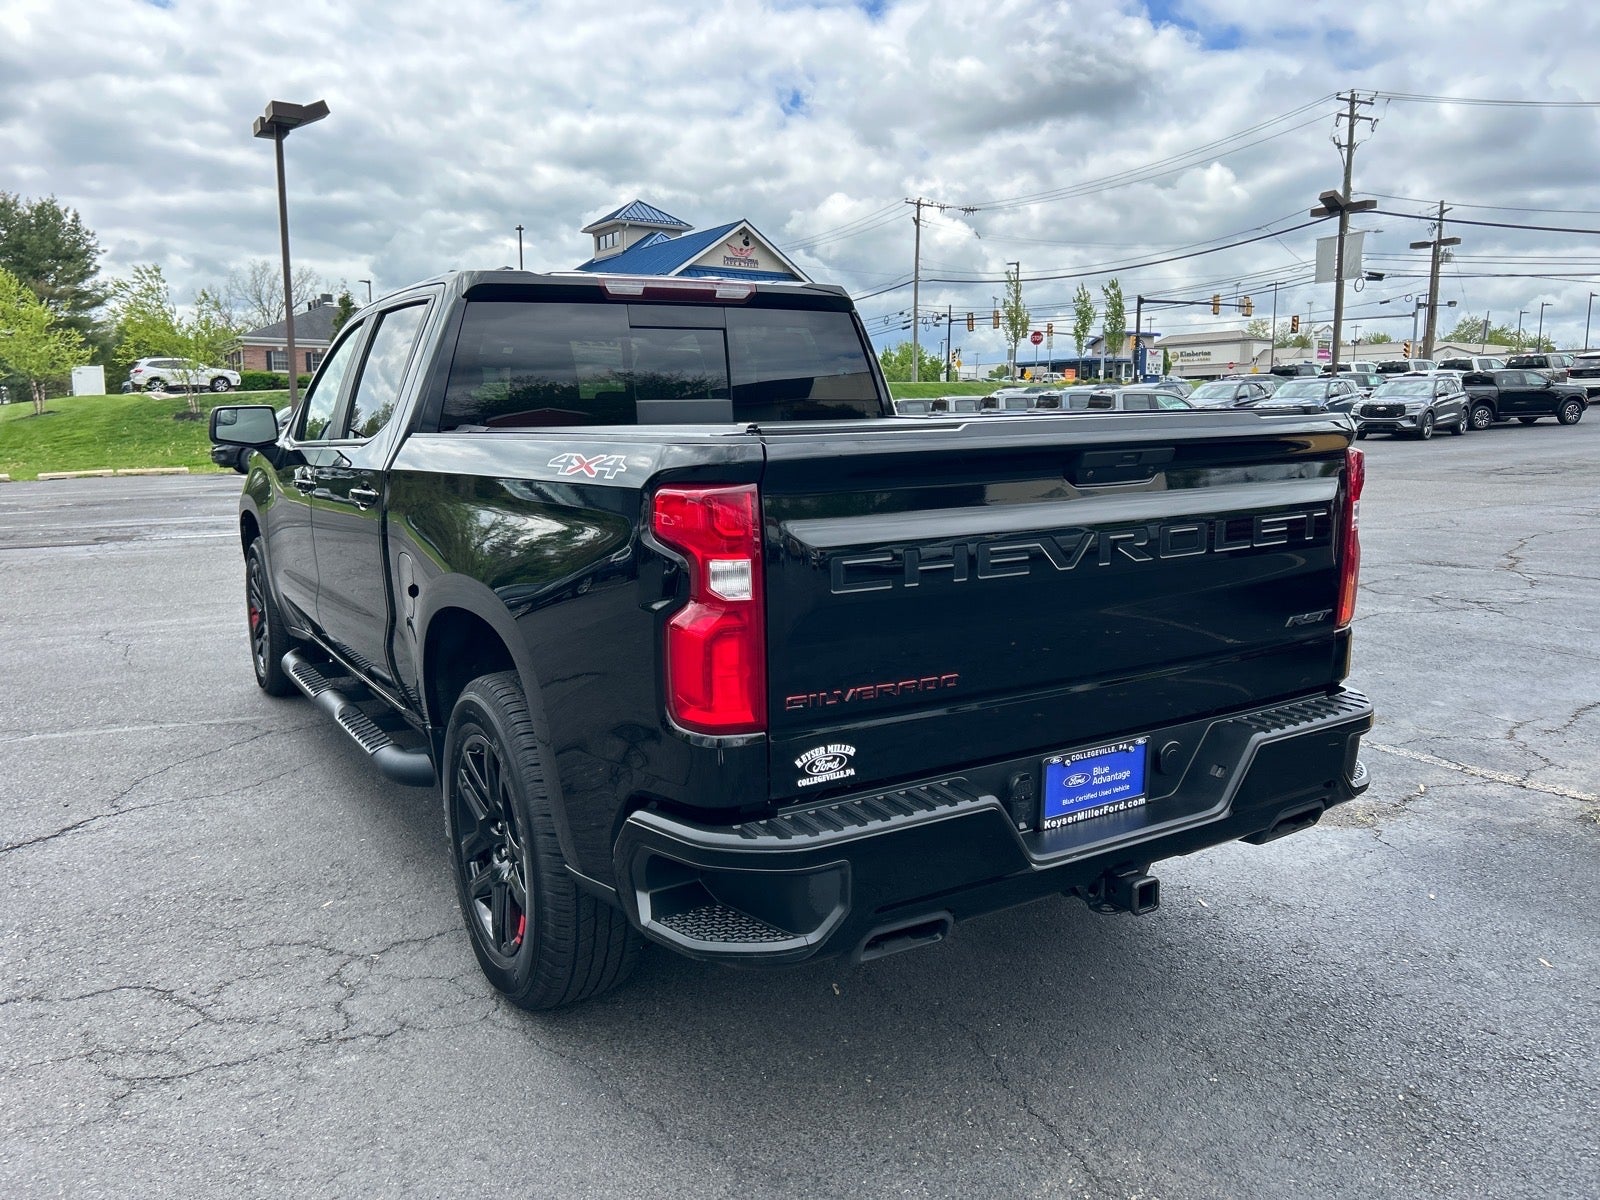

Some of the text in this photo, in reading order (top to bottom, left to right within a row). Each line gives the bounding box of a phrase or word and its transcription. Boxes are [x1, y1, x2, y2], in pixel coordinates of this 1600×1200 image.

[1180, 350, 1211, 358] Kimberton
[830, 508, 1328, 594] CHEVROLET
[1285, 609, 1333, 628] RST
[786, 673, 960, 711] SILVERADO
[794, 744, 856, 769] KEYSER MILLER
[1071, 746, 1117, 762] COLLEGEVILLE,
[1118, 743, 1127, 751] PA
[812, 756, 840, 773] Ford
[1092, 766, 1110, 776] Blue
[1068, 775, 1086, 787] Ford
[1092, 770, 1131, 785] Advantage
[1062, 783, 1130, 806] Blue Certified Used Vehicle
[1044, 797, 1146, 830] KeyserMillerFord.com
